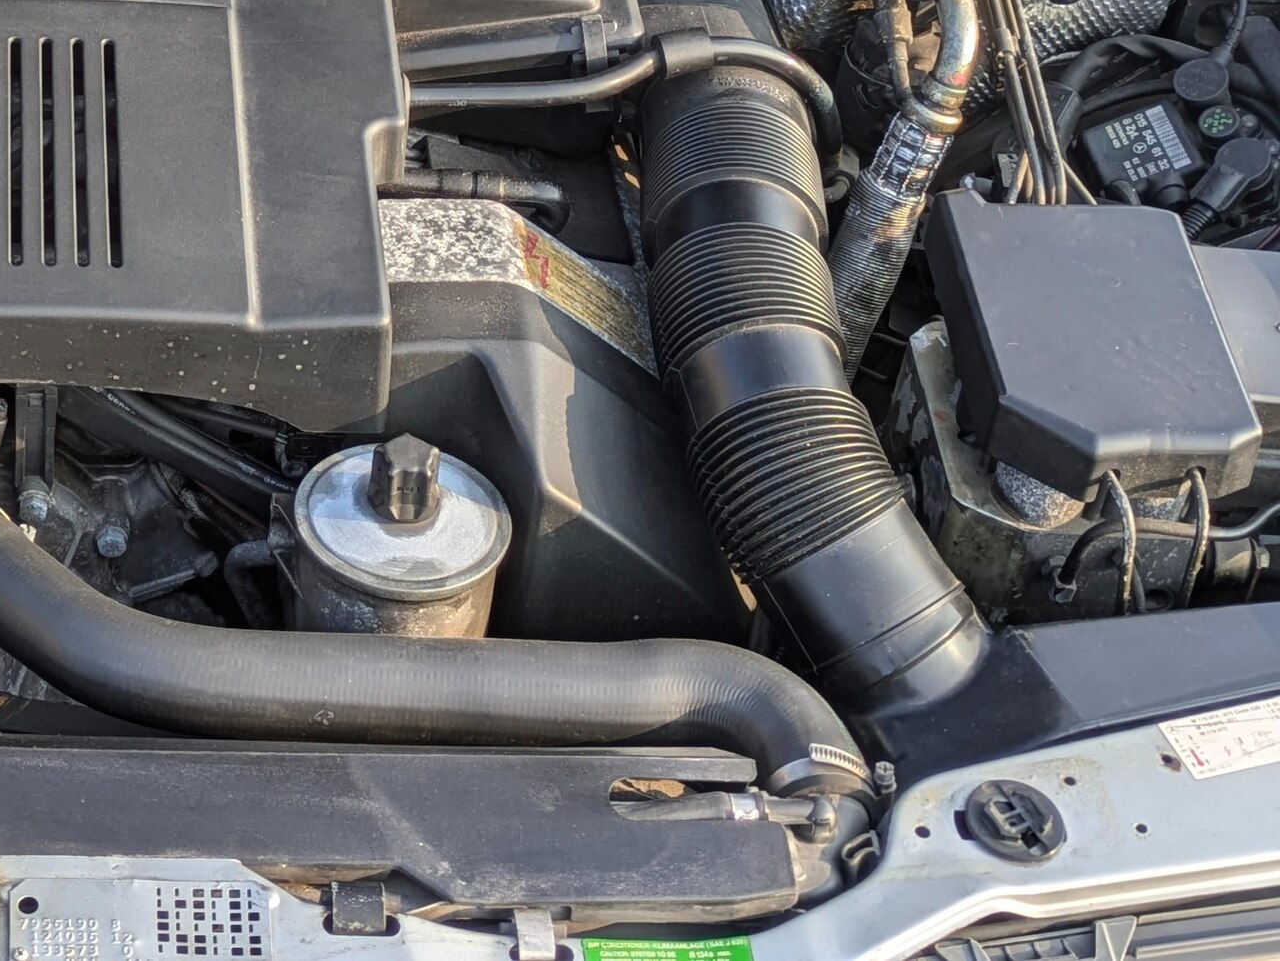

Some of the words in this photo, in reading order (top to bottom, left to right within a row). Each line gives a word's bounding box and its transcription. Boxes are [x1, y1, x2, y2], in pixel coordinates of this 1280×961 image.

[19, 918, 98, 931] 7956190
[110, 919, 121, 931] 8
[31, 931, 99, 944] 124036
[112, 932, 133, 944] 12
[32, 944, 99, 957] 133573
